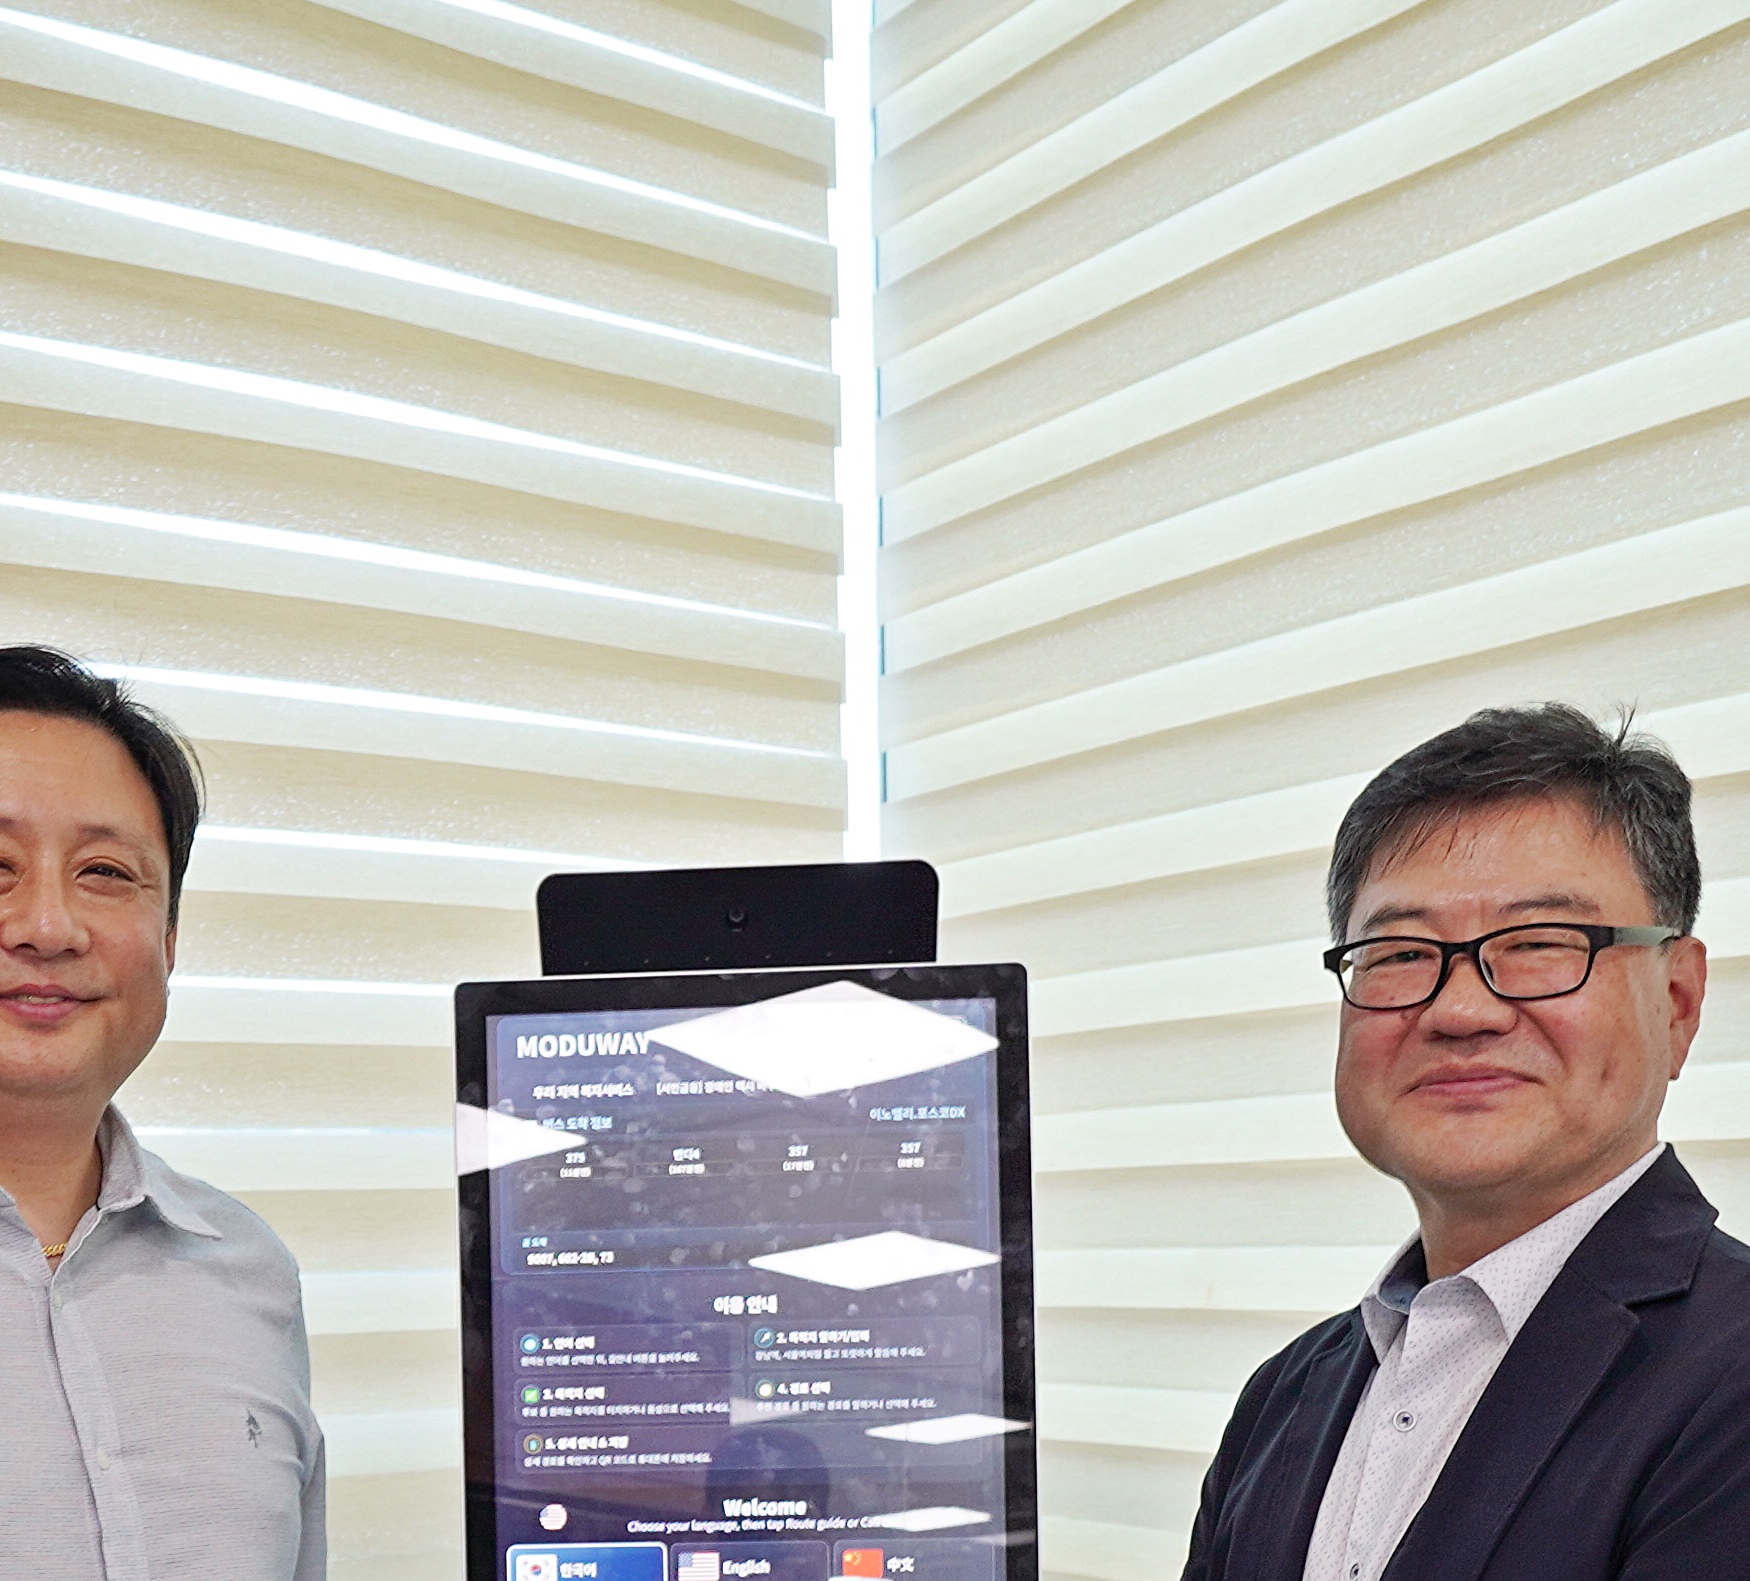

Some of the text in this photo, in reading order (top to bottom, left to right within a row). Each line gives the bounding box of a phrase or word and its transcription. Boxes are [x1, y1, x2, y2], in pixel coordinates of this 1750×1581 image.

[516, 1031, 650, 1059] MODUWAY
[566, 1117, 589, 1130] 도착
[590, 1115, 613, 1129] 정보
[714, 1294, 778, 1315] 이용 안내
[723, 1498, 807, 1516] Welcome
[627, 1520, 665, 1533] Choose
[666, 1521, 690, 1534] your
[691, 1519, 740, 1533] language,
[741, 1518, 765, 1531] then
[766, 1518, 784, 1532] tap
[785, 1517, 816, 1530] Route
[817, 1516, 845, 1531] guide
[846, 1517, 859, 1529] or
[560, 1562, 597, 1578] 한국어
[723, 1559, 771, 1577] English
[887, 1557, 915, 1573] 中文
